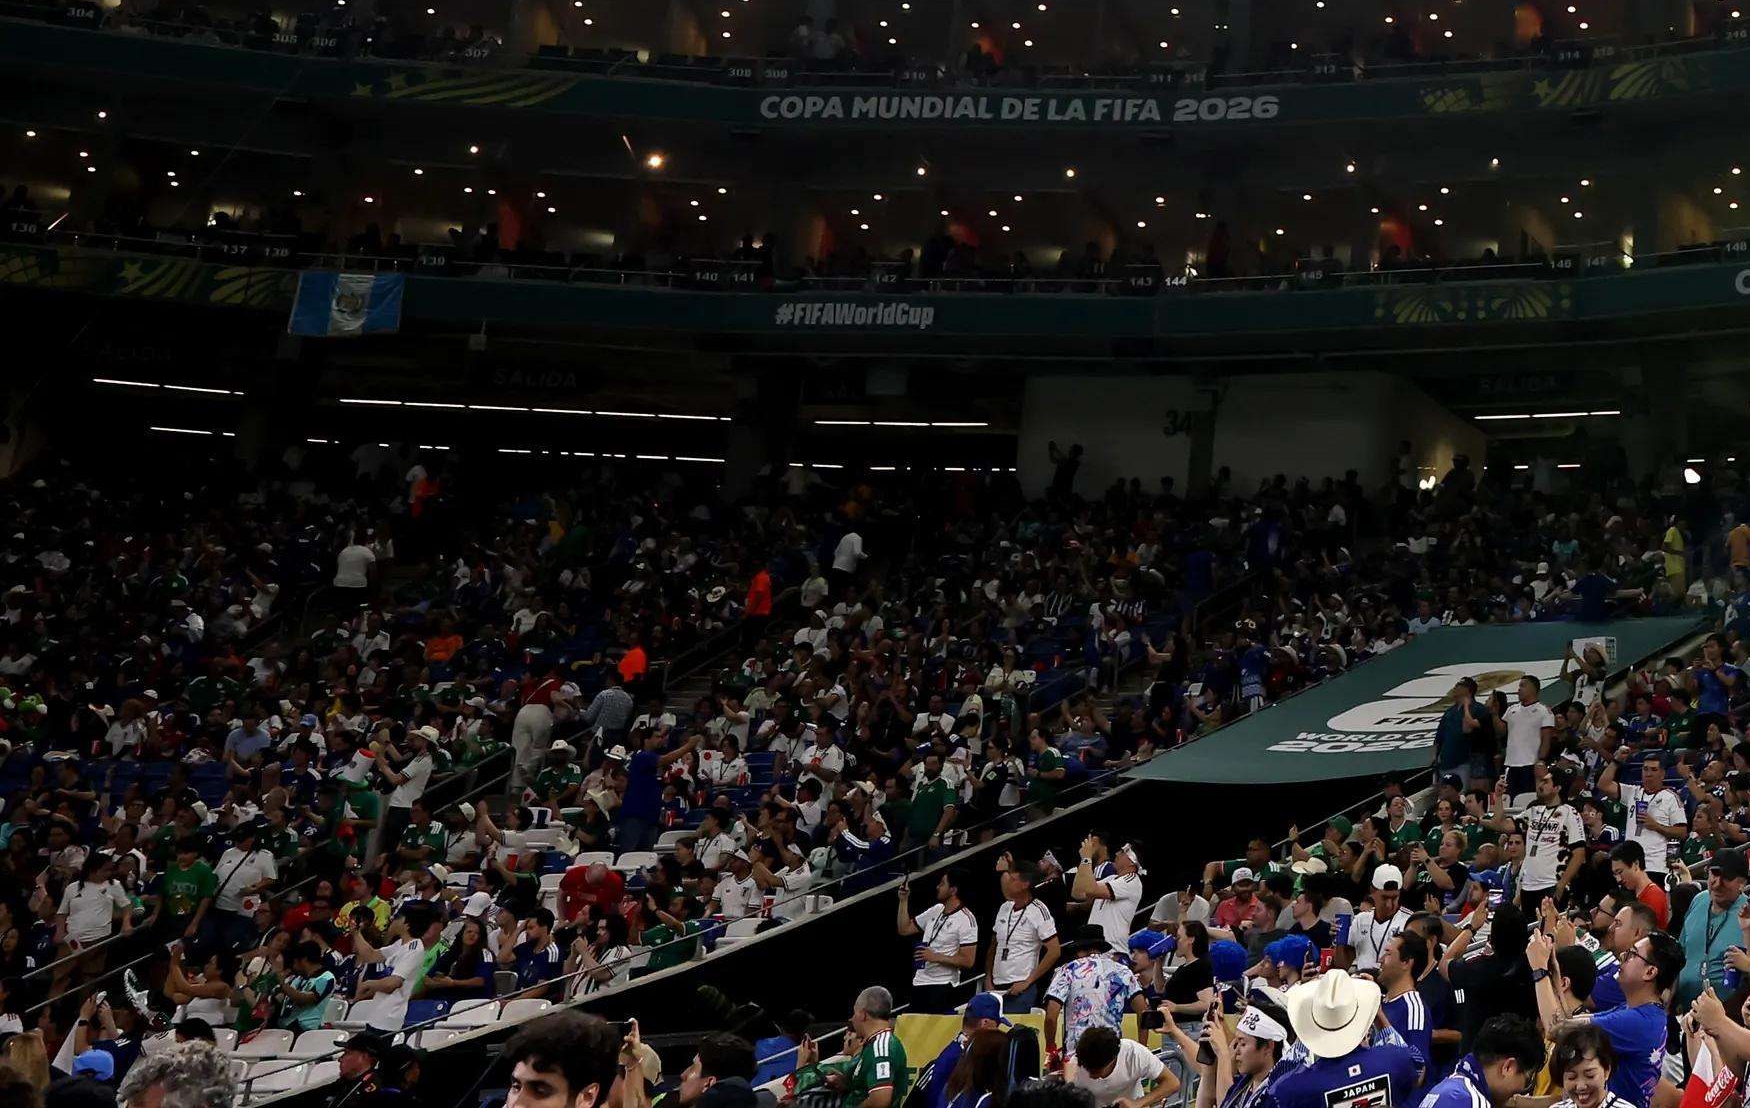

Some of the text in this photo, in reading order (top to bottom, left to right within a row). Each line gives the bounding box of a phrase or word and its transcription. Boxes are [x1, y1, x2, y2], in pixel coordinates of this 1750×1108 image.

[464, 48, 489, 59] 307
[759, 95, 1280, 122] COPA MUNDIAL DE LA FIFA 2026
[223, 244, 248, 255] 137
[733, 272, 755, 282] 141
[1164, 276, 1187, 286] 144
[774, 302, 935, 330] #FIFAWorldCup
[492, 364, 577, 389] SALIDA
[1163, 410, 1192, 437] 34
[1295, 731, 1402, 742] WORLD
[1265, 738, 1436, 753] 2026
[1343, 1082, 1376, 1099] JAPAN
